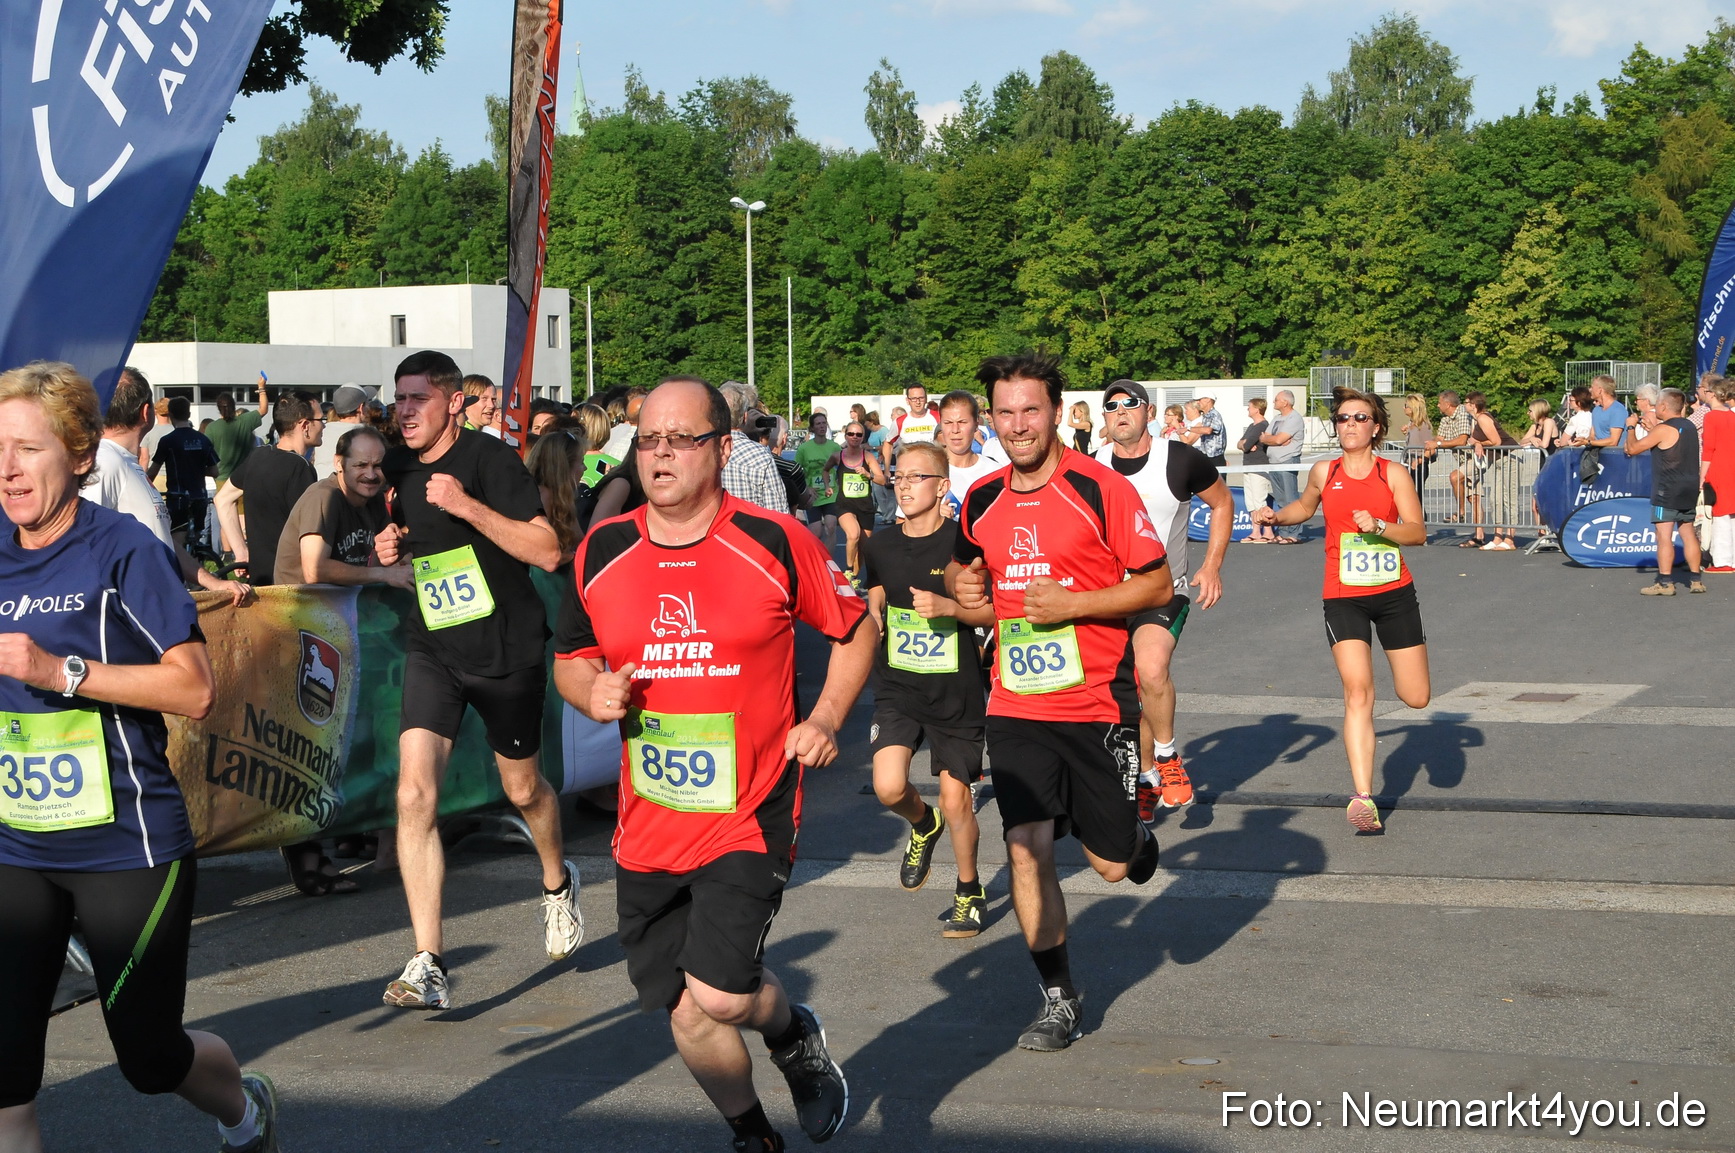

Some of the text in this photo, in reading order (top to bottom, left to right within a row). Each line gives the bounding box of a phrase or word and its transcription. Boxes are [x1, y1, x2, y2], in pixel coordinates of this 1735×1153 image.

[158, 0, 212, 115] AUT
[847, 482, 865, 492] 730
[1596, 528, 1679, 545] Fischr
[1604, 545, 1658, 553] AUTOMOB
[1005, 563, 1051, 578] MEYER
[1342, 551, 1397, 573] 1318
[424, 573, 476, 610] 315
[29, 593, 85, 614] POLES
[642, 642, 714, 661] MEYER
[896, 631, 945, 657] 252
[1008, 642, 1066, 676] 863
[631, 662, 741, 679] rdertechnik GmbH
[1019, 675, 1040, 683] Alexander
[306, 700, 325, 718] 1628
[242, 701, 341, 791] Neumarkt
[641, 744, 716, 788] 859
[0, 753, 84, 802] 359
[206, 733, 335, 829] Lammsb
[646, 788, 661, 798] Meyer
[659, 784, 679, 795] Michael
[17, 801, 72, 811] Ramona Pietzsch
[34, 813, 53, 821] GmbH
[106, 957, 133, 1011] DYNAFIT
